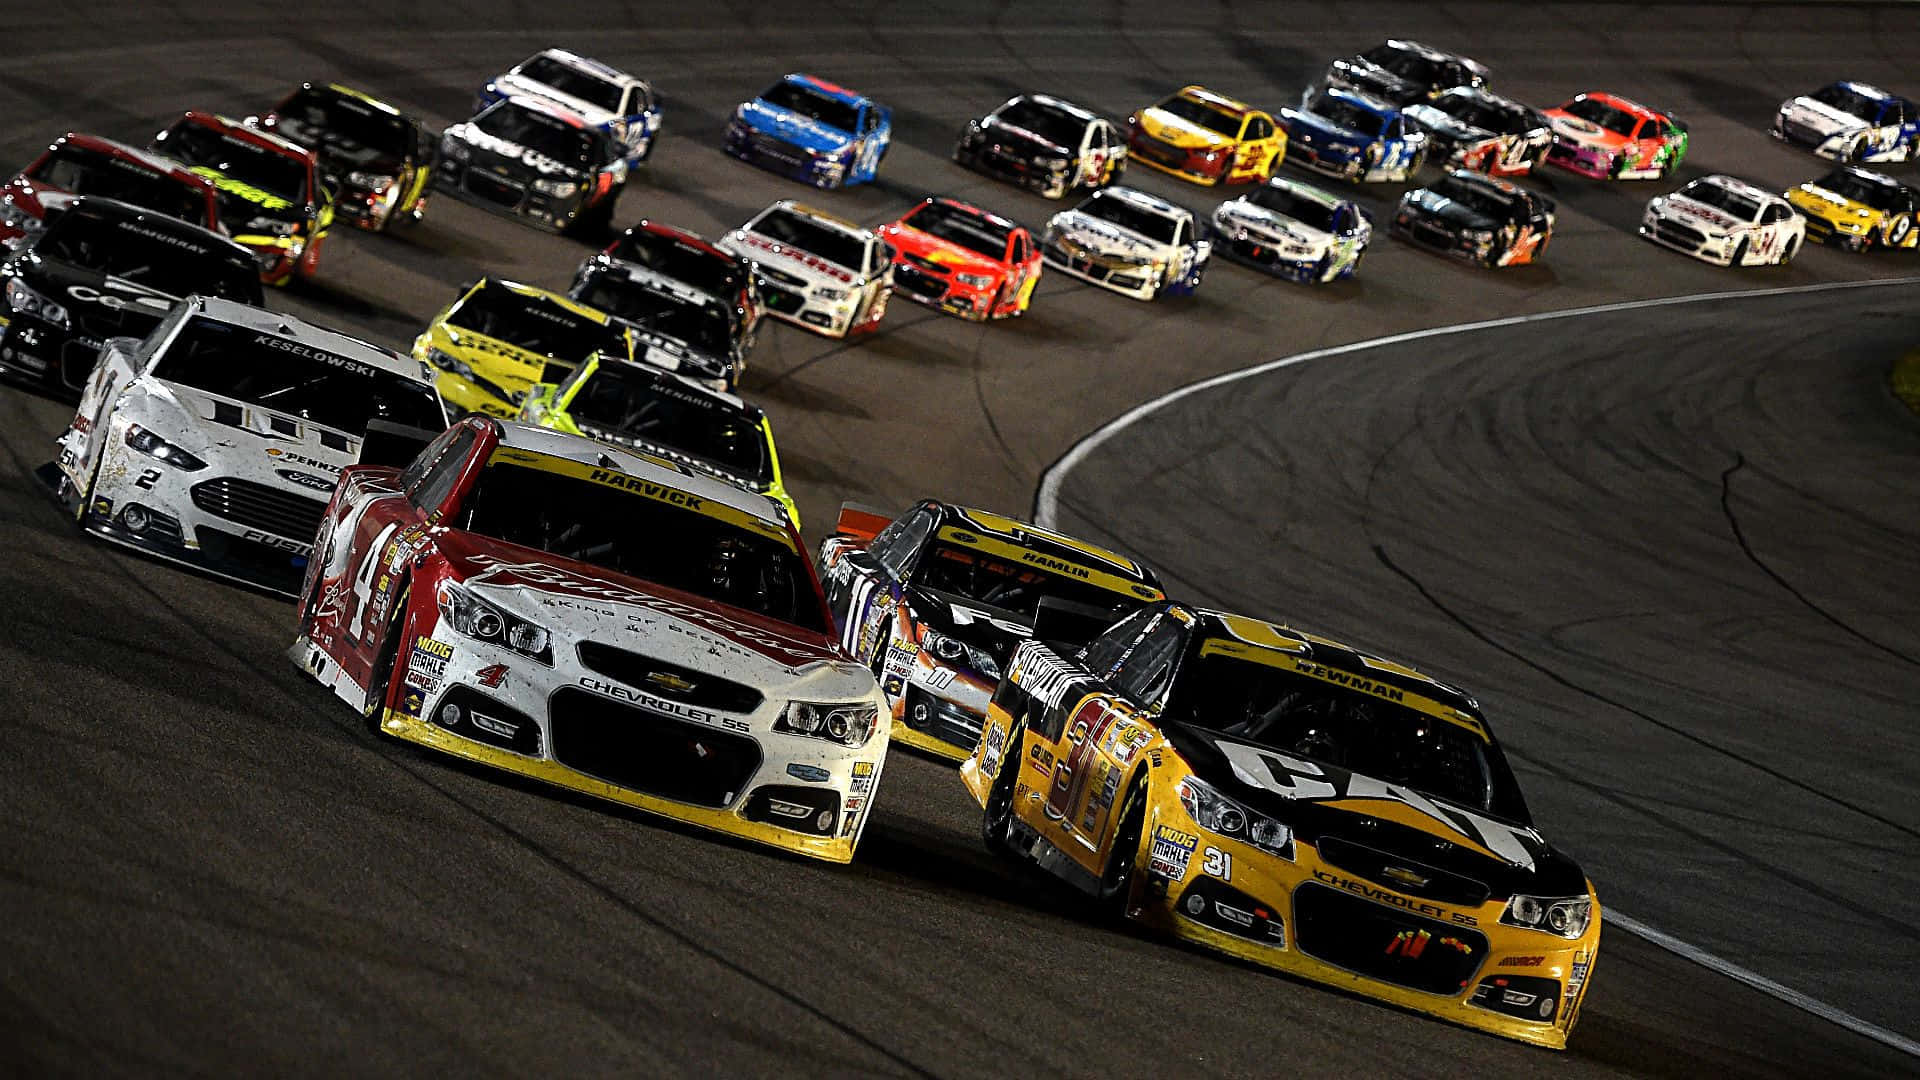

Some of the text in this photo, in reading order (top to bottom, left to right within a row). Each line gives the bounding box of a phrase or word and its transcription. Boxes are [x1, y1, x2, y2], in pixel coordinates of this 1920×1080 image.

[254, 334, 377, 378] KESELOWSKI
[285, 452, 344, 475] PENNZ
[134, 467, 162, 490] 2
[288, 472, 332, 492] Ford
[590, 469, 702, 511] HARVICK
[1022, 551, 1090, 580] HAMLIN
[348, 519, 402, 641] 4
[558, 599, 615, 618] KING
[627, 612, 657, 626] OF
[417, 635, 453, 658] MOOG
[887, 648, 917, 667] MAHLE
[892, 637, 919, 655] MOOG
[410, 651, 447, 677] MAHLE
[475, 663, 510, 689] 4
[1294, 659, 1404, 702] NEWMAN
[579, 676, 751, 734] CHEVROLET SS
[1159, 827, 1196, 850] MOOG
[1152, 842, 1191, 864] MAHLE
[1202, 846, 1233, 882] 31
[1316, 870, 1478, 927] CHEVROLET SS
